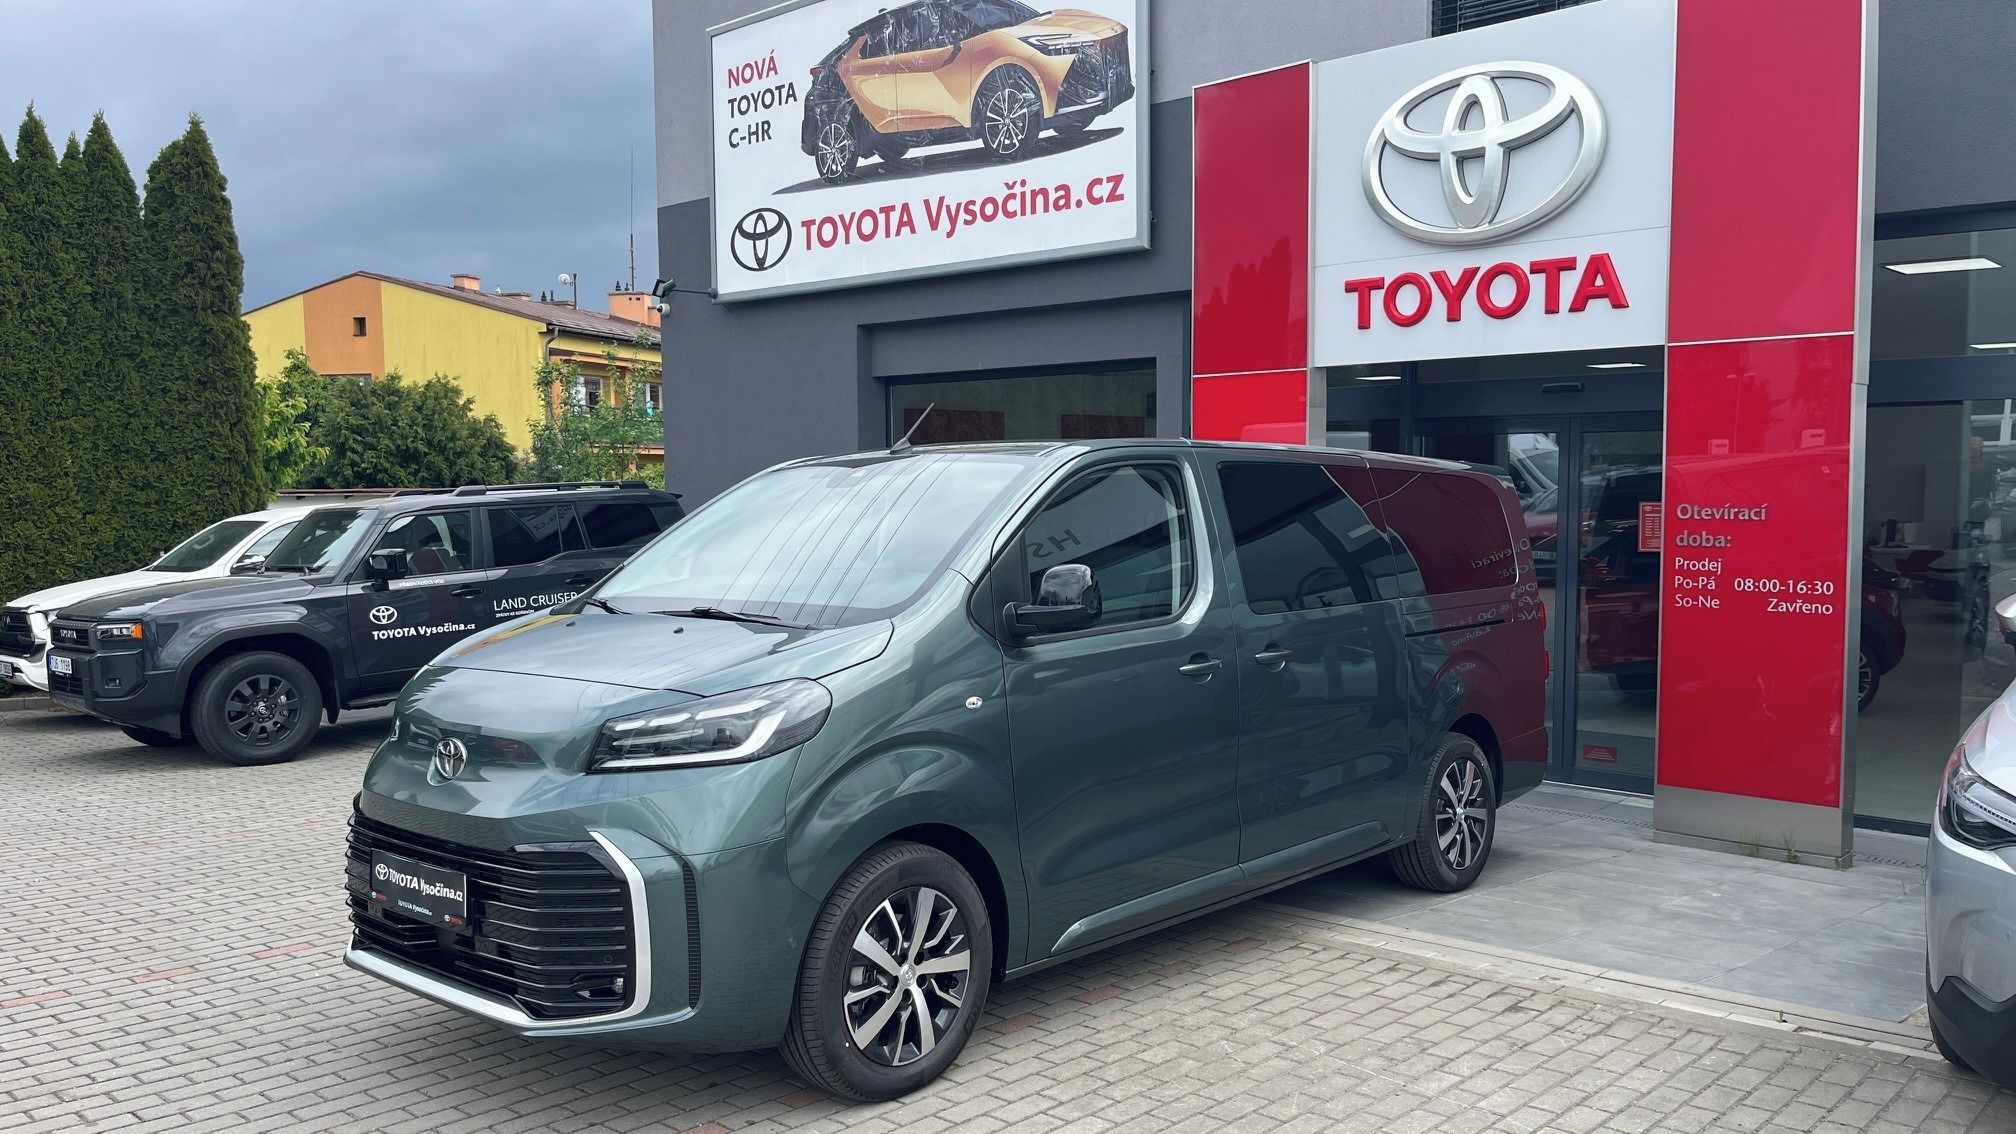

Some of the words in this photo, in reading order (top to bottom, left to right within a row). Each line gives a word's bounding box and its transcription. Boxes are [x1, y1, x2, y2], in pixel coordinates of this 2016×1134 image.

[727, 49, 779, 89] NOVÁ
[727, 82, 798, 118] TOYOTA
[728, 120, 773, 149] C-HR
[801, 202, 917, 251] TOYOTA
[923, 173, 1125, 238] Vysočina.cz
[1344, 252, 1629, 330] TOYOTA
[1676, 502, 1768, 521] Otevírací
[1676, 531, 1732, 548] doba:
[1675, 557, 1722, 574] Prodej
[1675, 575, 1716, 591] Po-Pá
[1734, 577, 1834, 596] 08:00-16:30
[494, 597, 527, 611] LAND
[1675, 594, 1720, 609] So-Ne
[1767, 598, 1833, 616] Zavřeno
[372, 627, 417, 640] TOYOTA
[418, 622, 476, 636] Vysočina.cz
[389, 869, 419, 890] TOYOTA
[421, 878, 463, 902] Vysočina.cz
